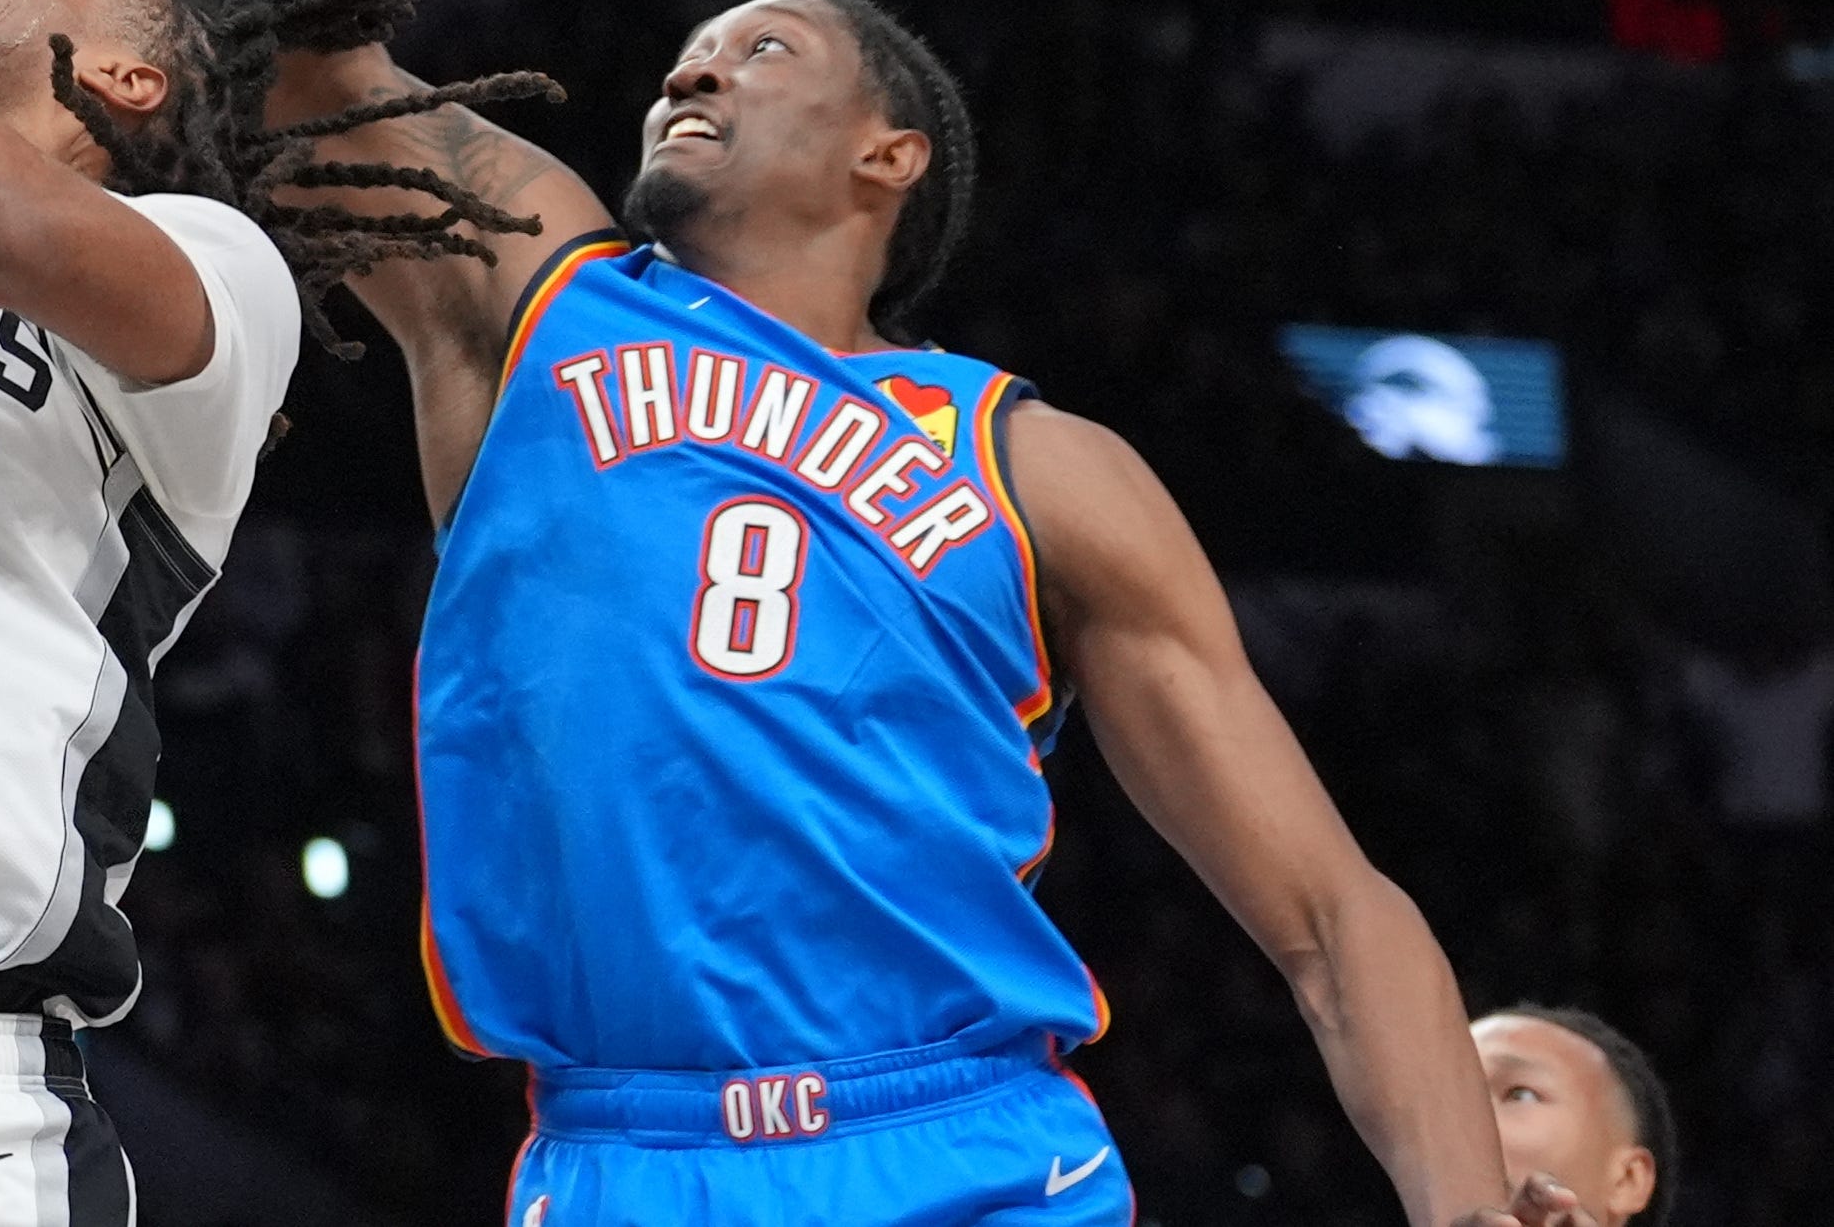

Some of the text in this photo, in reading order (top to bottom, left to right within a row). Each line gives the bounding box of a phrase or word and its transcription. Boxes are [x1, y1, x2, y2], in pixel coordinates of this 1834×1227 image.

[552, 341, 995, 581] THUNDER
[688, 494, 810, 682] 8
[721, 1071, 830, 1142] OKC
